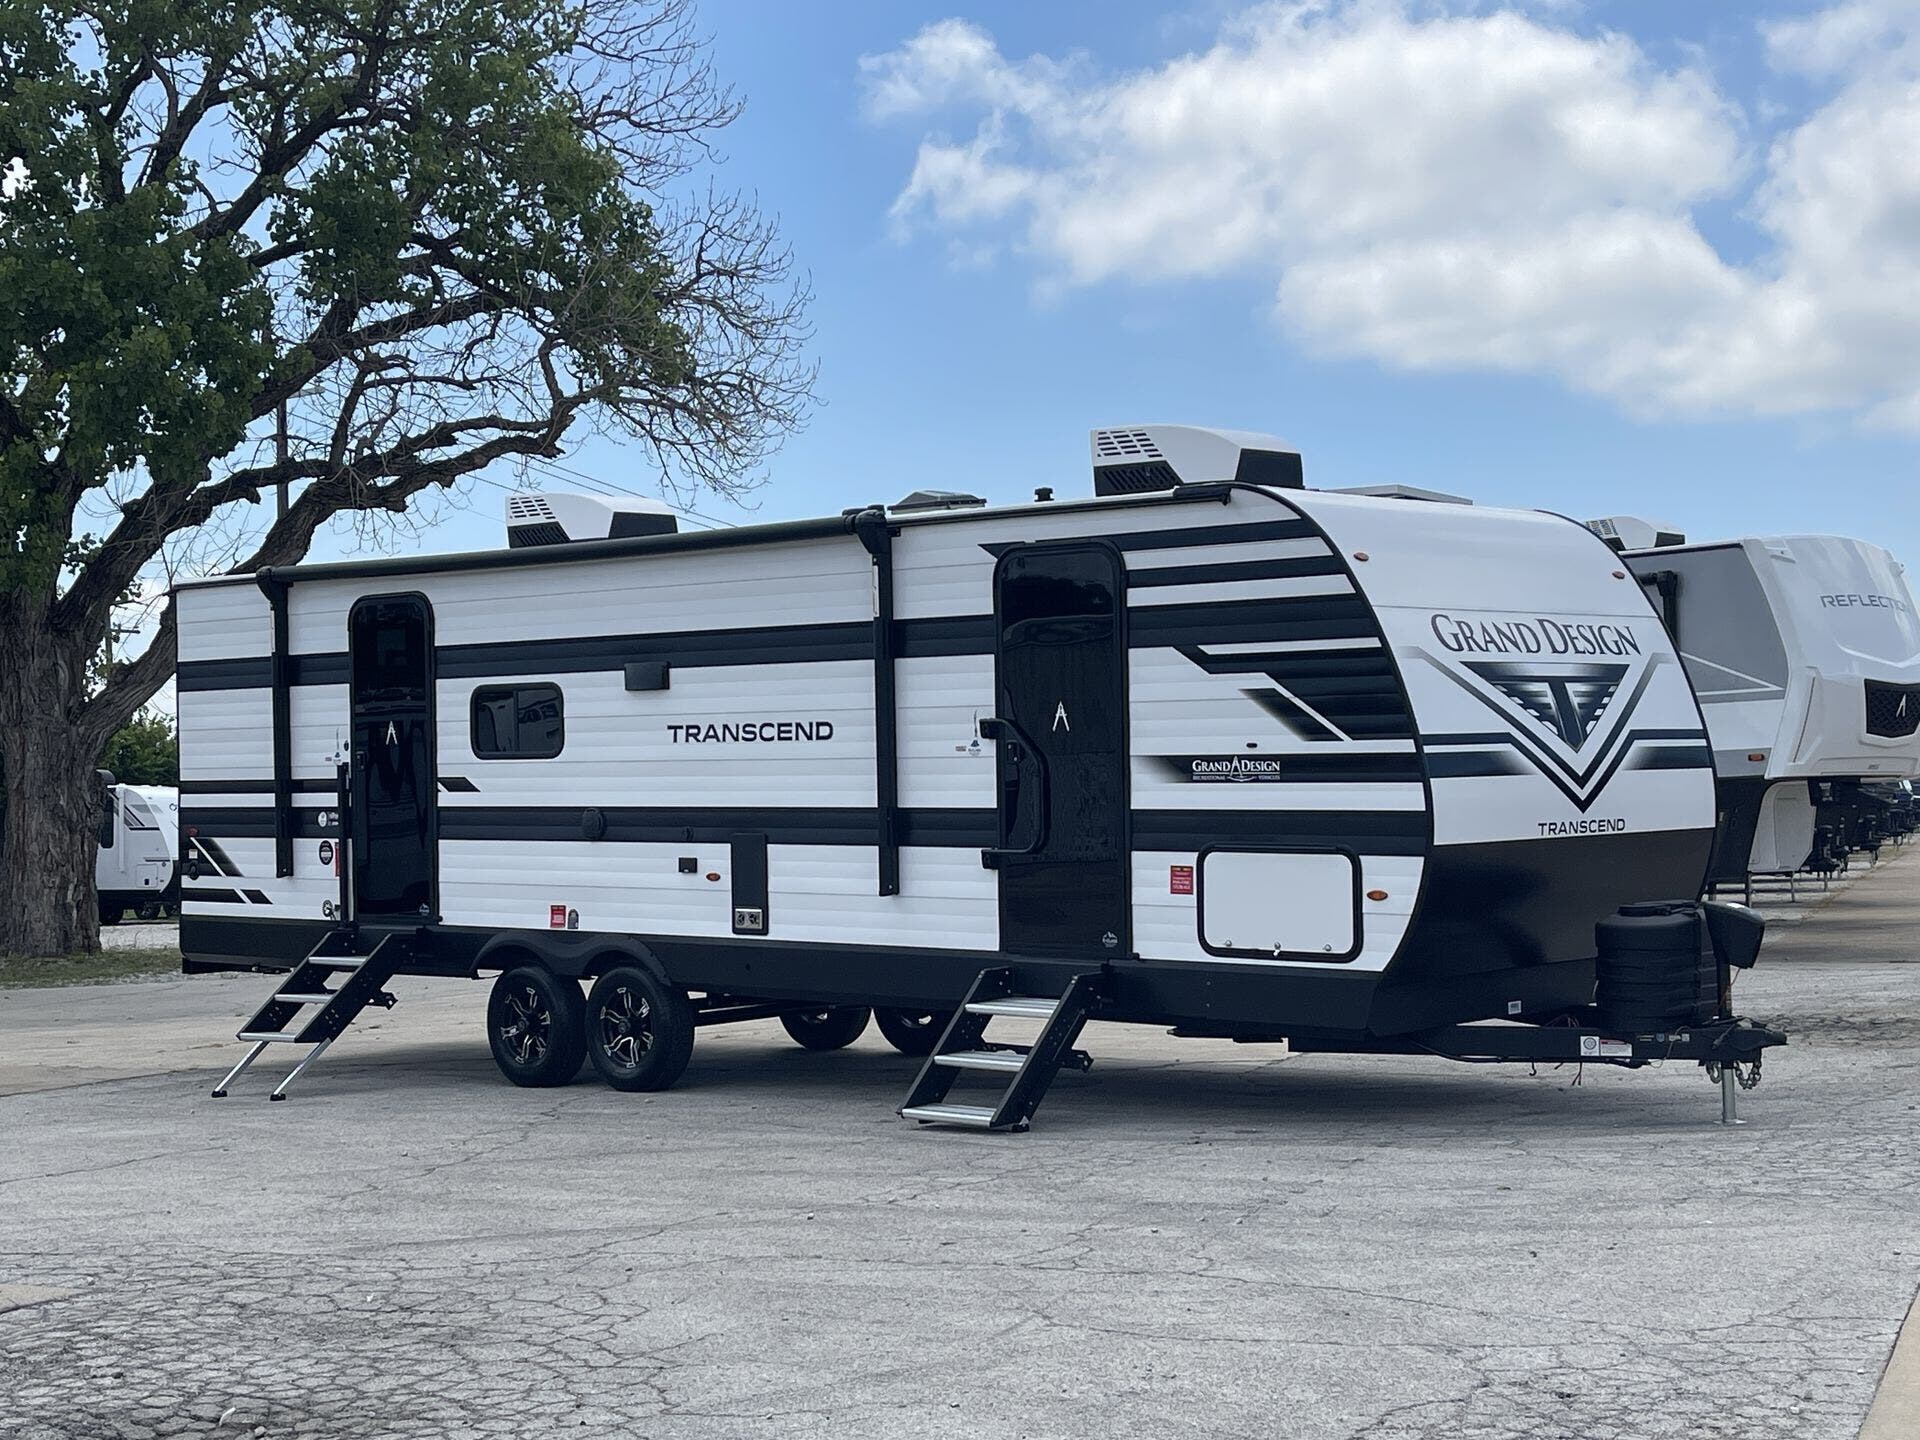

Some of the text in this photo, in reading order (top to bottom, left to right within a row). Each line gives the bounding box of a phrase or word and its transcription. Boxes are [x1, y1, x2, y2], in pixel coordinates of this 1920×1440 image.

[1431, 613, 1641, 656] GRAND DESIGN
[667, 721, 834, 743] TRANSCEND
[1192, 759, 1281, 772] GRAND DESIGN
[1538, 818, 1626, 836] TRANSCEND
